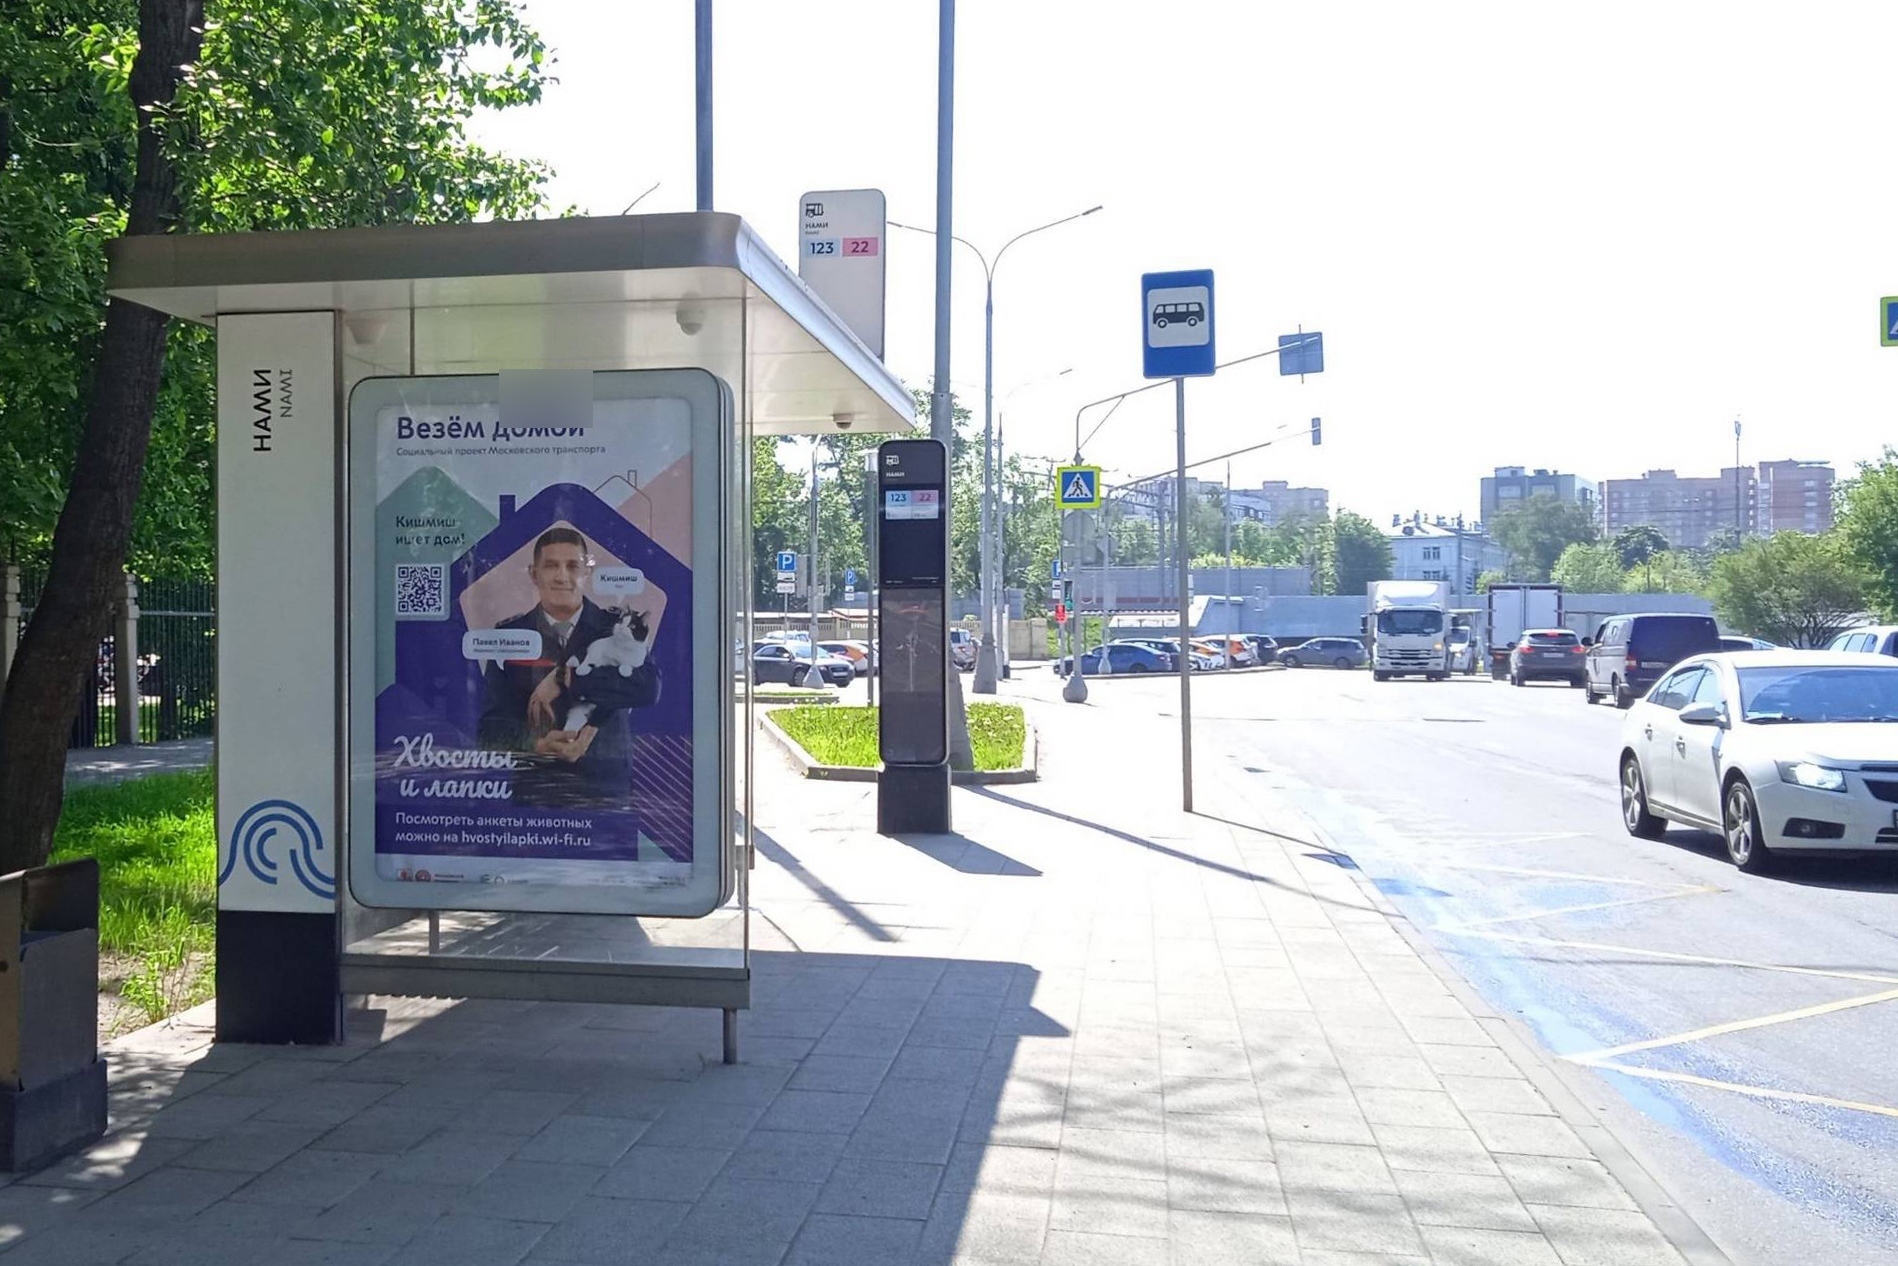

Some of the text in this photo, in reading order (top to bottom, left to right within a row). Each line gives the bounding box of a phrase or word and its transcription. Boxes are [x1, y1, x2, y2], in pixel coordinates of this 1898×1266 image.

[811, 241, 869, 254] 123 22
[279, 369, 293, 418] NAMI
[253, 369, 272, 452] НАМИ
[397, 415, 485, 440] Везём
[455, 448, 486, 456] проект
[488, 446, 550, 455] Московского
[552, 446, 606, 455] транспорта
[891, 493, 931, 502] 123 22
[396, 516, 455, 528] Кишмиш
[433, 533, 465, 546] дом!
[600, 574, 637, 582] Кишмиш
[499, 638, 530, 646] Иванов
[393, 732, 517, 769] Хвосты
[400, 779, 513, 799] и лапки
[395, 812, 592, 829] Посмотреть анкеты животных
[395, 831, 591, 847] можно на hvostyilapki.wi-fi.ru
